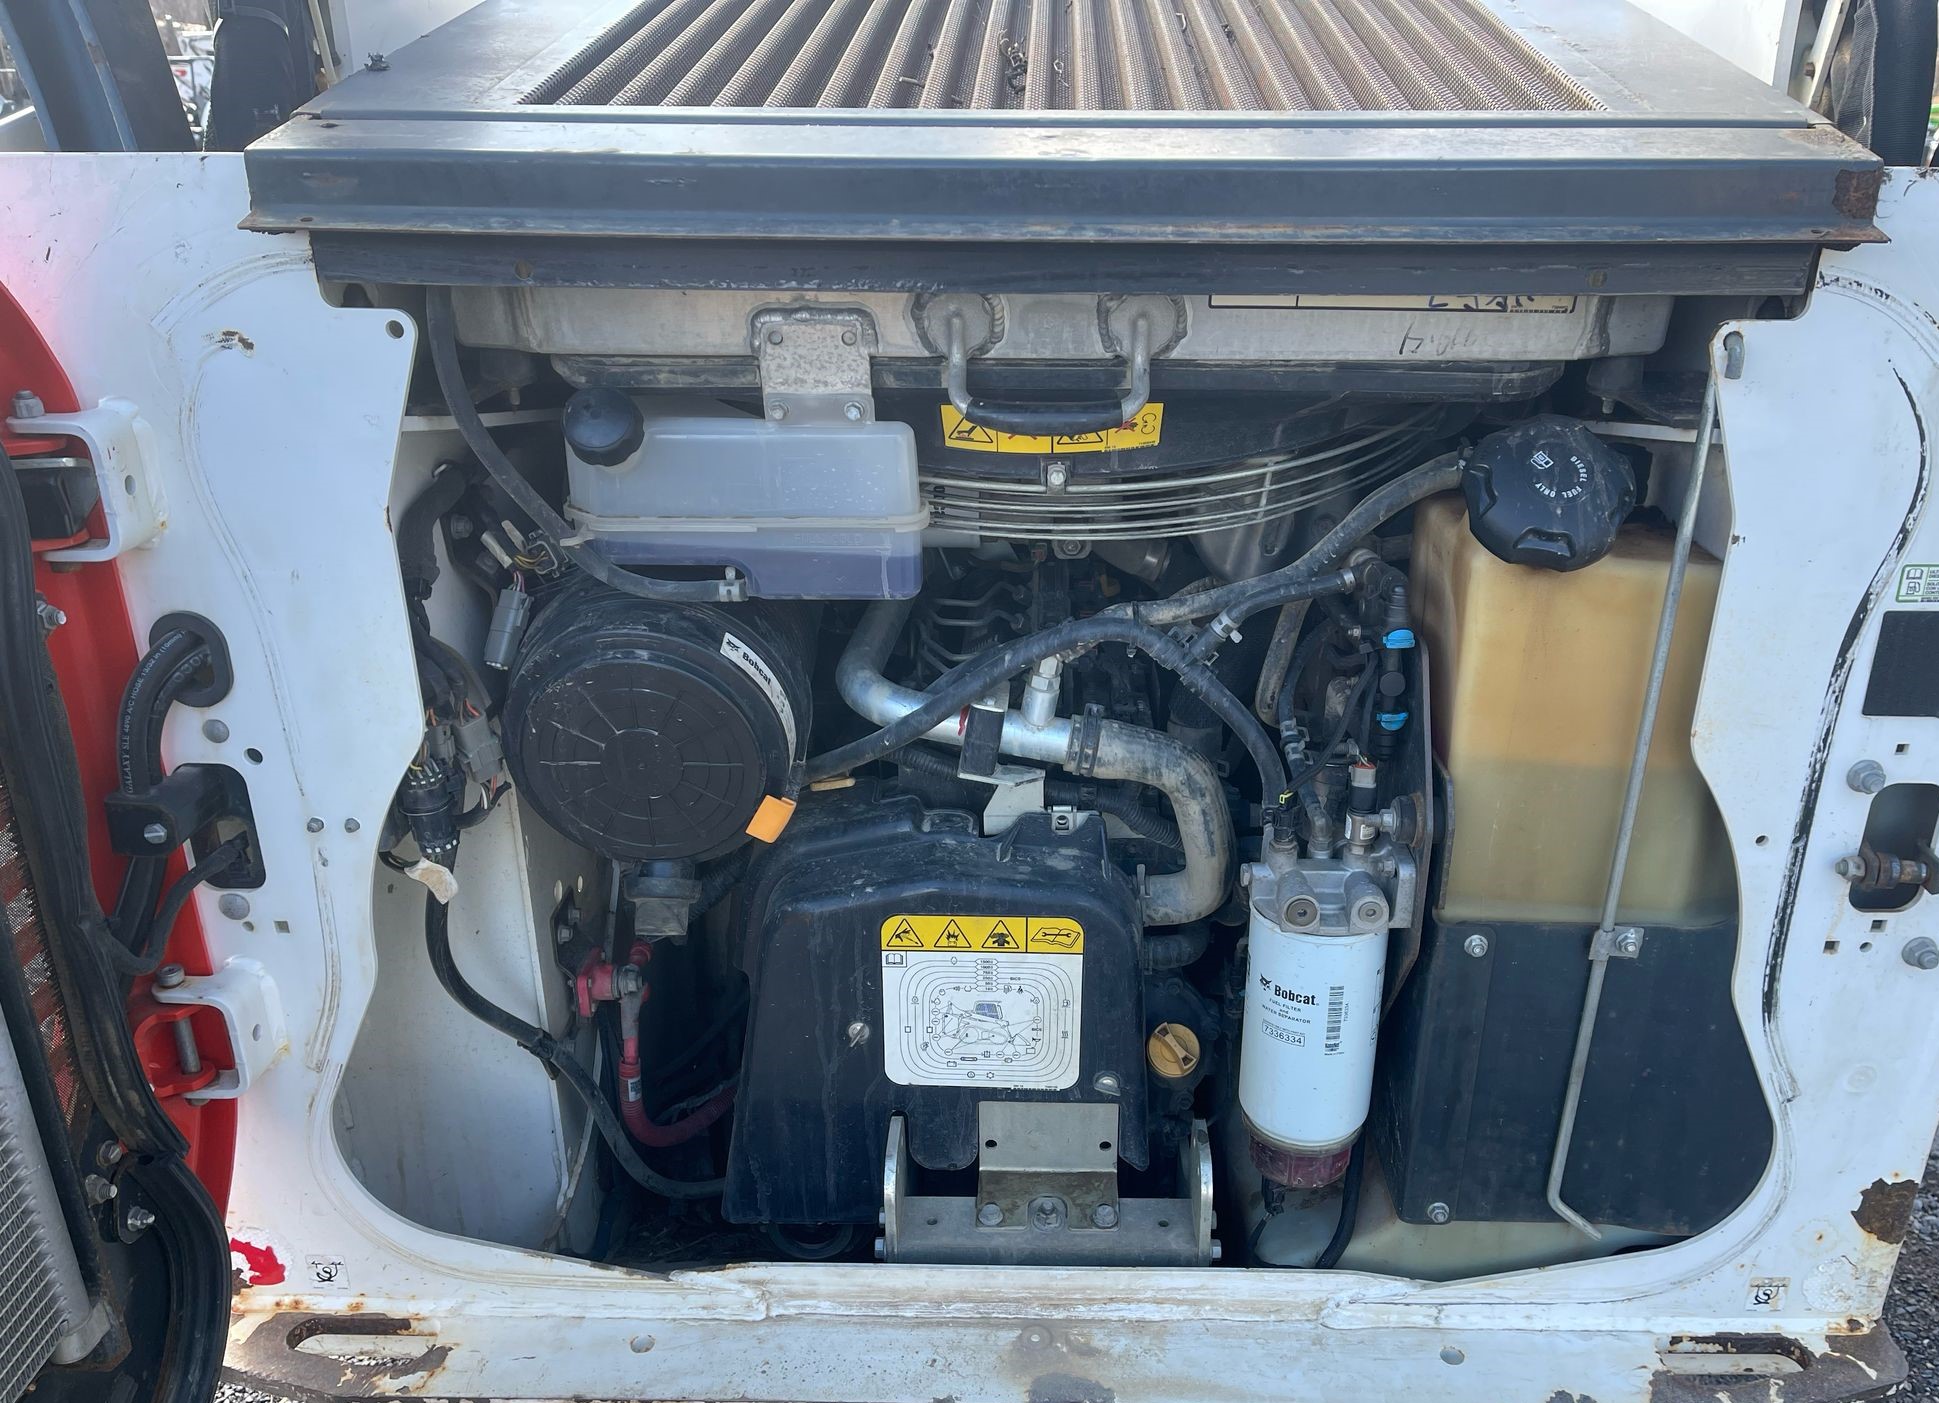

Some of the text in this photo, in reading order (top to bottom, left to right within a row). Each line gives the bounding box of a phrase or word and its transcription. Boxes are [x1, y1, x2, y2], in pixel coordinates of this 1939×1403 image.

[1534, 455, 1588, 499] DIESEL FUEL ONLY
[742, 651, 771, 686] Bobcat
[131, 678, 144, 700] HOSE
[1269, 997, 1302, 1013] FUEL FILTER
[1274, 984, 1316, 1006] Bobcat
[1278, 1012, 1311, 1025] SEPARATOR
[1264, 1025, 1302, 1044] 7336334
